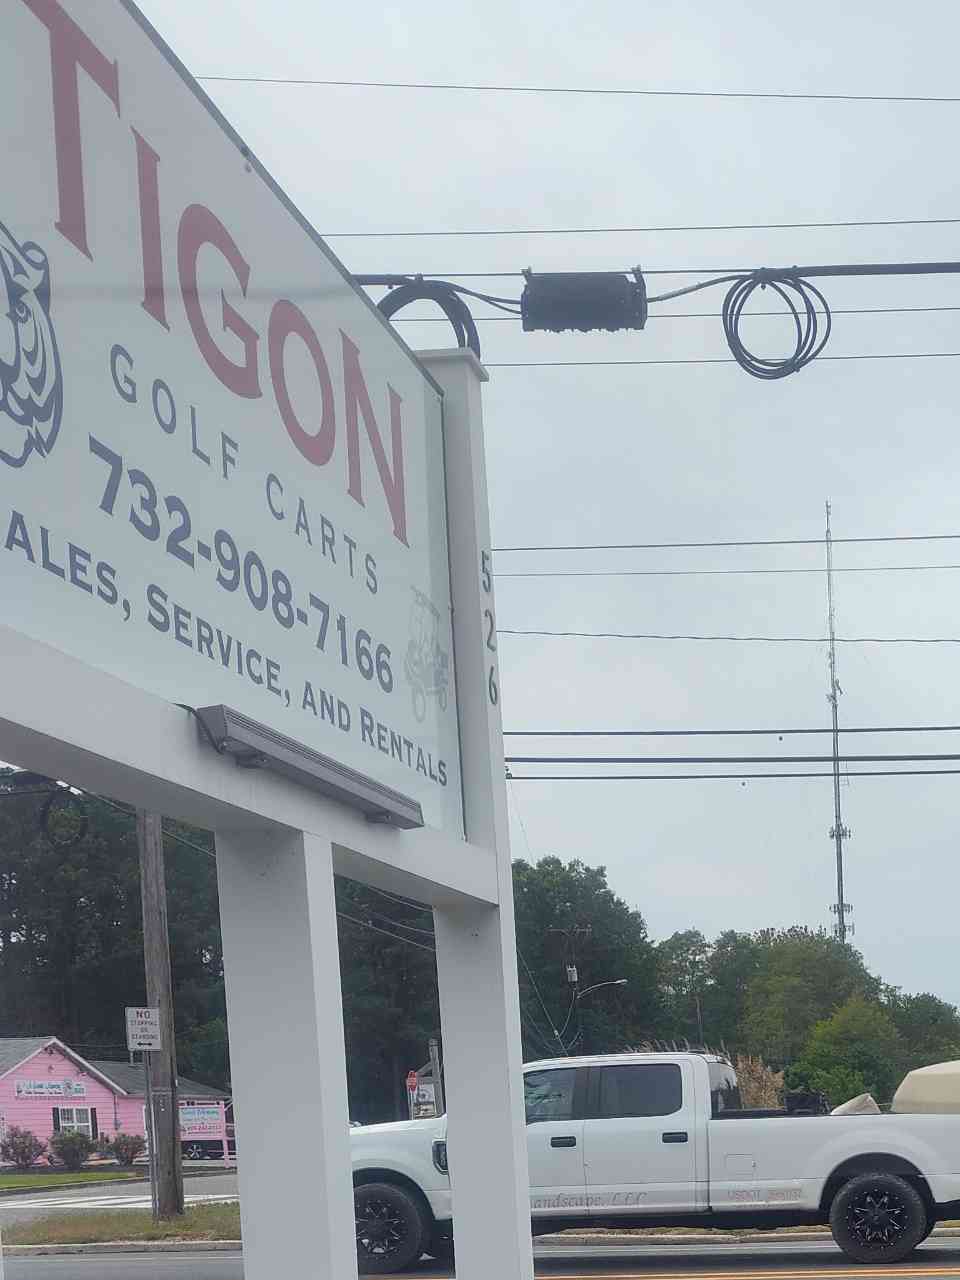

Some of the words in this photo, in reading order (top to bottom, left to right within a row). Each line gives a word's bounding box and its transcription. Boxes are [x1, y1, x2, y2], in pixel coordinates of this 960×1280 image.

[22, 0, 410, 549] TIGON
[88, 432, 395, 694] 732-908-7166
[110, 343, 240, 480] GOLF
[265, 472, 379, 595] CARTS
[146, 583, 292, 708] SERVICE,
[301, 681, 351, 733] AND
[360, 706, 449, 787] RENTALS
[136, 1010, 150, 1019] NO
